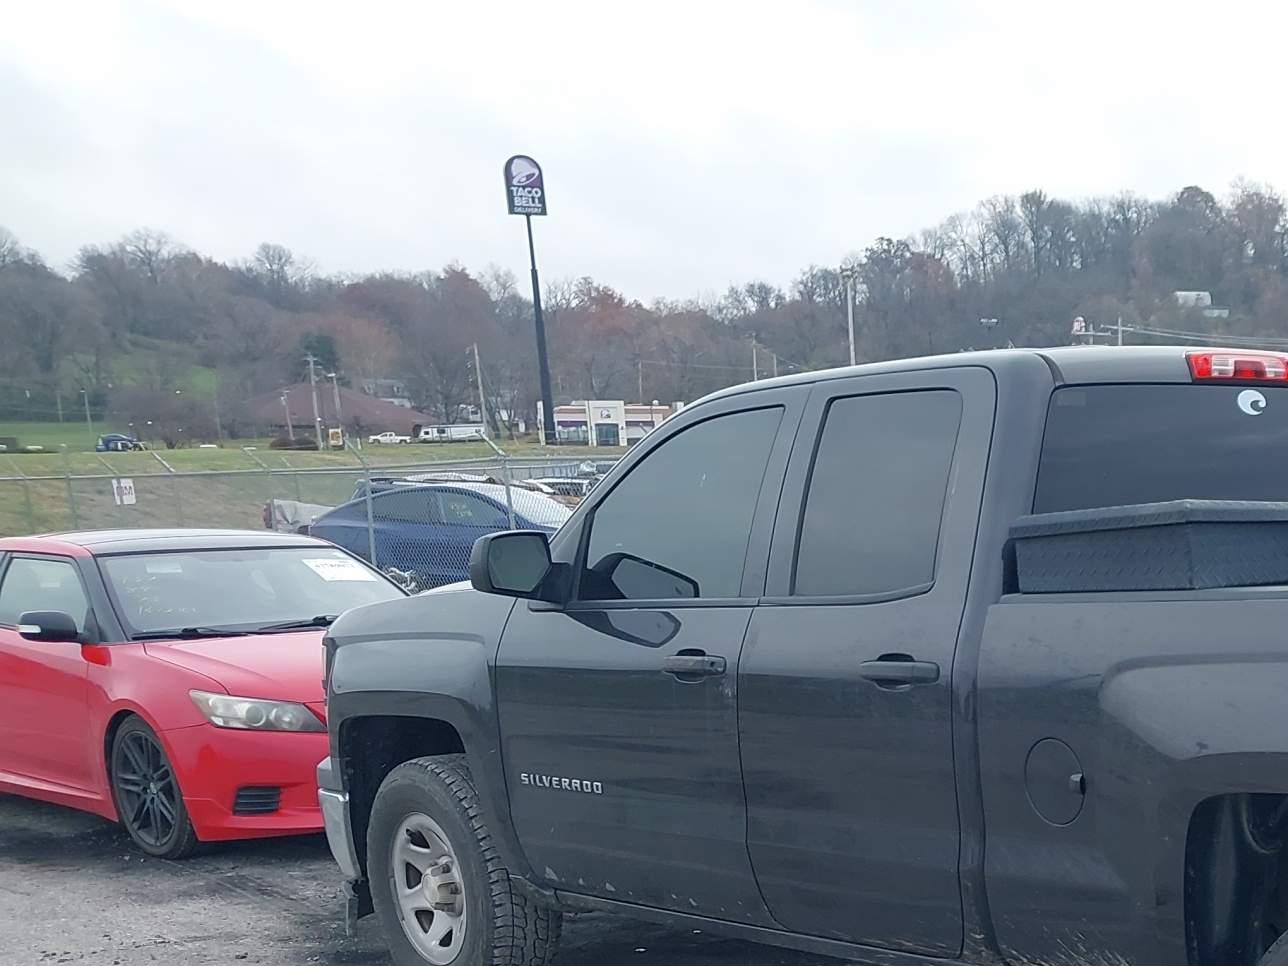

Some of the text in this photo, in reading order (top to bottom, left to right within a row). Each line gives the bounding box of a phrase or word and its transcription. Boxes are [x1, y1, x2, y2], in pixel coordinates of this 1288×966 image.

[510, 186, 541, 198] TACO
[514, 196, 542, 207] BELL
[520, 773, 602, 794] SILVERADO
